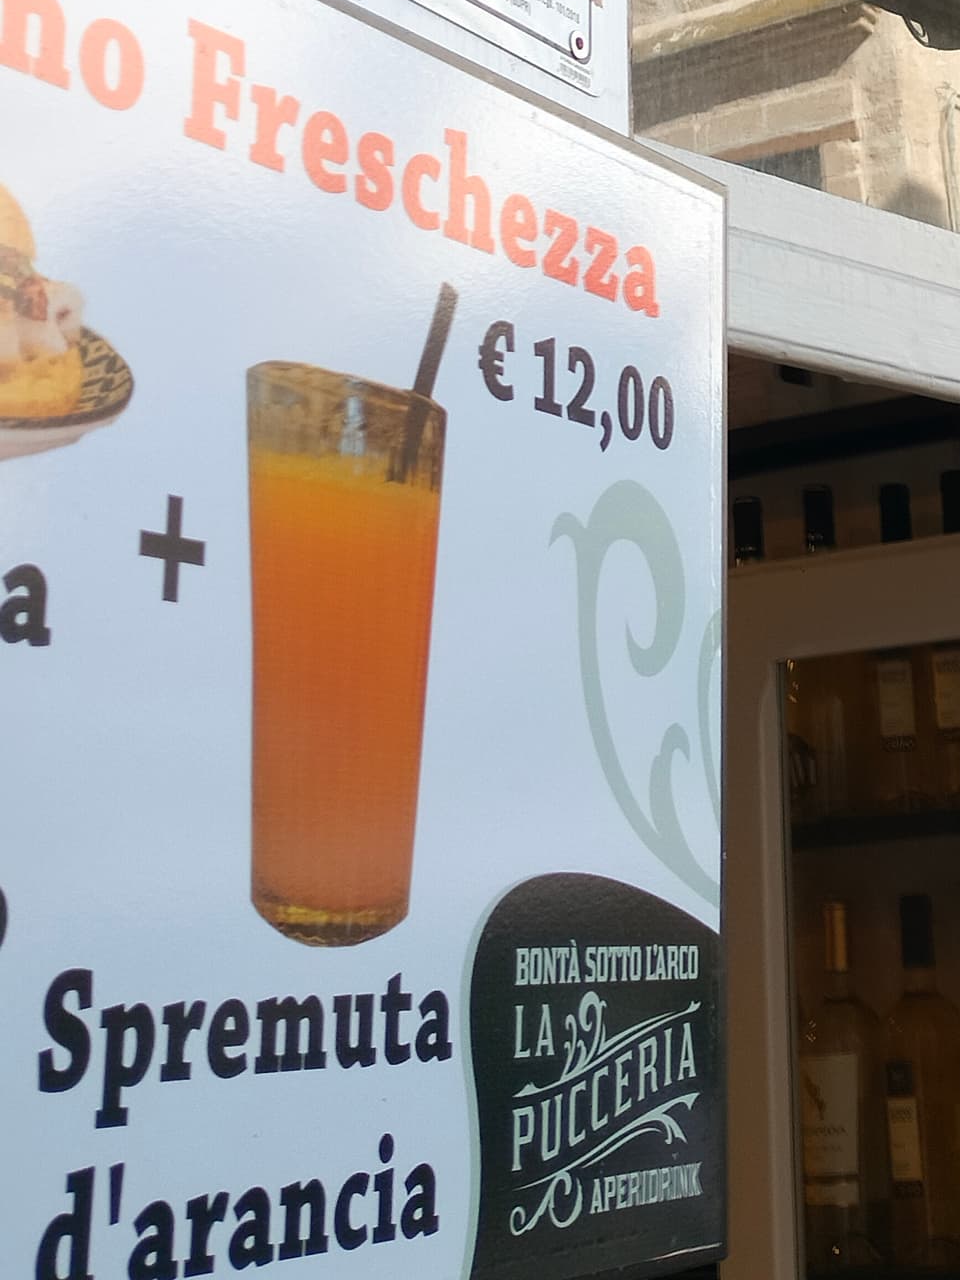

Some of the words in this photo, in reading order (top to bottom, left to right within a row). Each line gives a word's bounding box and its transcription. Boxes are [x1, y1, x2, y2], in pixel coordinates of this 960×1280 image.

[182, 16, 662, 319] Freschezza
[477, 320, 516, 402] €
[533, 336, 675, 453] 12,00
[0, 563, 51, 647] a
[514, 939, 581, 986] BONTÀ
[585, 945, 641, 982] SOTTO
[645, 944, 699, 981] L'ARCO
[37, 967, 453, 1129] Spremuta
[511, 1022, 697, 1171] PUCCERIA
[513, 1004, 555, 1059] LA
[35, 1133, 440, 1280] d'arancia
[589, 1161, 704, 1215] APERIDRINK
